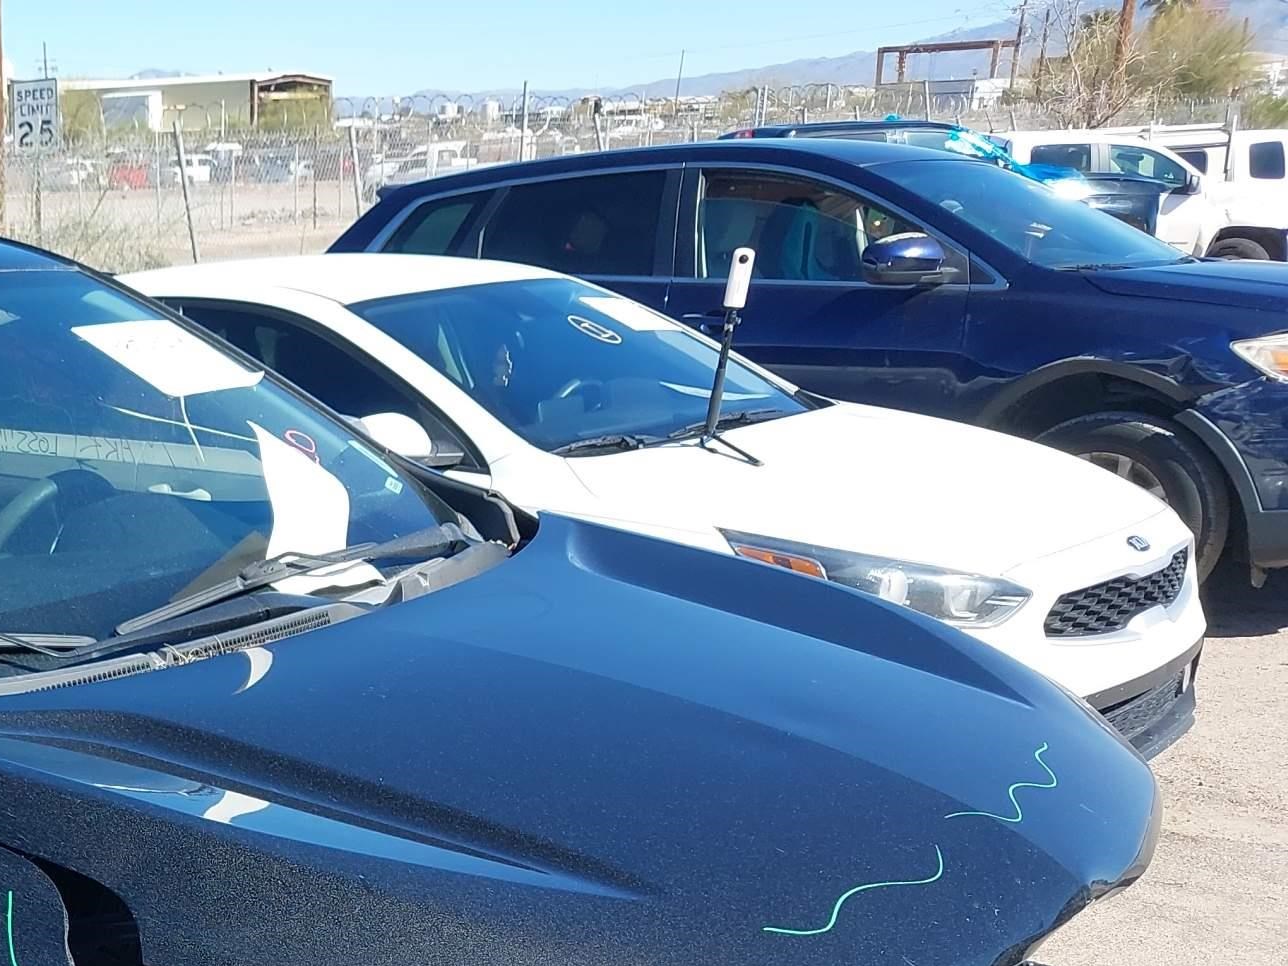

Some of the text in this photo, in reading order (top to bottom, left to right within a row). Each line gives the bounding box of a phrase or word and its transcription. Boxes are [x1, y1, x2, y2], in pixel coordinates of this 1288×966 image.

[16, 88, 54, 102] SPEED
[20, 103, 51, 117] LIMIT
[18, 119, 54, 147] 25
